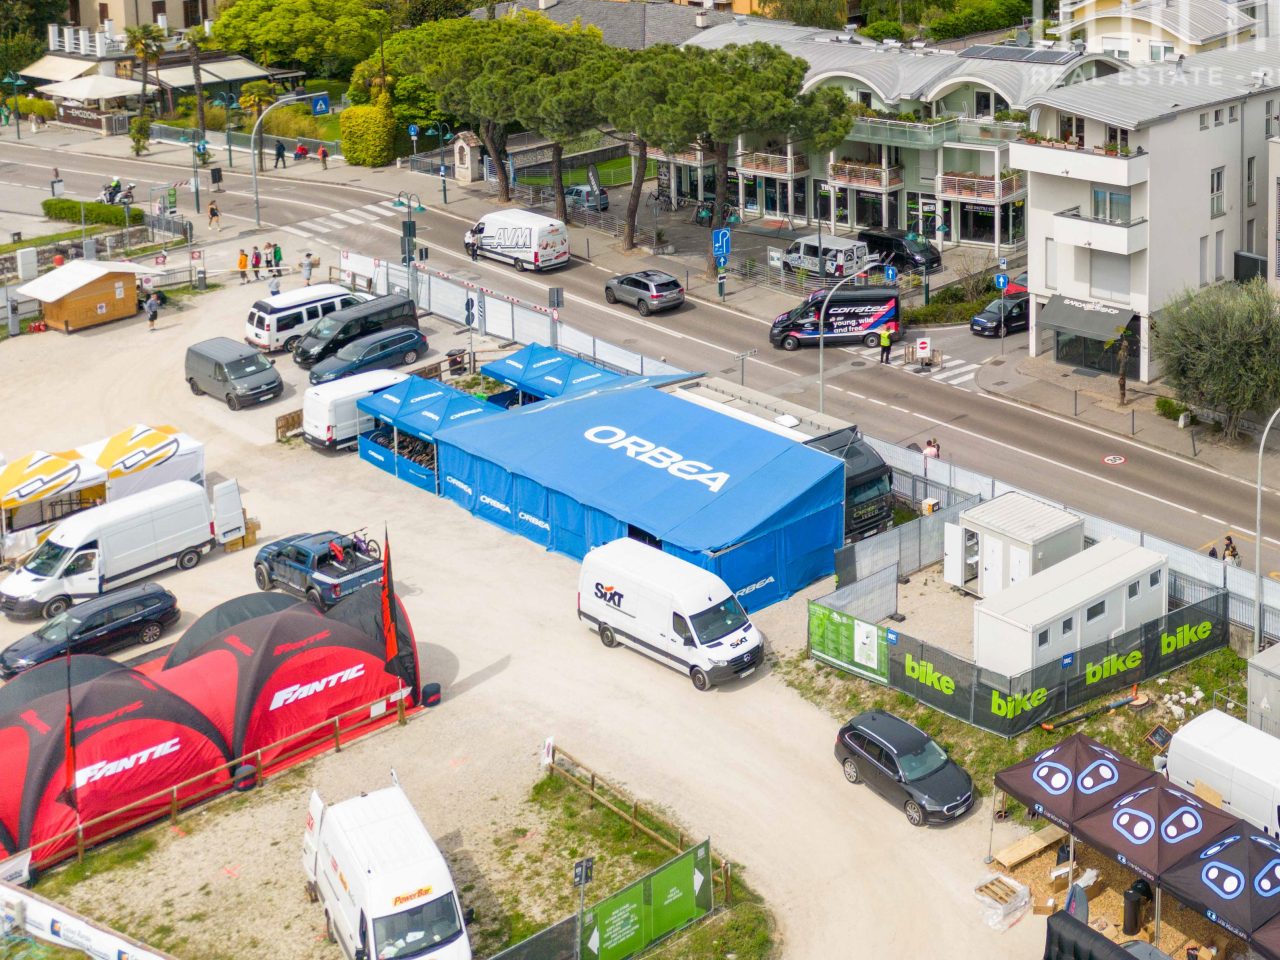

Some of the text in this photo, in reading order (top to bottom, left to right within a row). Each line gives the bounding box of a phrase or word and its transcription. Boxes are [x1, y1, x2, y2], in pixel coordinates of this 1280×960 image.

[489, 228, 532, 248] AVM
[829, 305, 889, 314] corratec
[584, 426, 730, 492] ORBEA
[446, 475, 472, 495] ORBEA
[480, 495, 511, 514] ORBEA
[519, 511, 550, 531] ORBEA
[594, 582, 624, 608] SIXT
[735, 575, 776, 598] RBEA
[1161, 621, 1212, 656] bike
[905, 654, 955, 695] bike
[1085, 649, 1142, 685] bike
[269, 663, 365, 711] FANTIC
[991, 687, 1048, 718] bike
[75, 737, 181, 788] FANTIC
[394, 886, 432, 906] PowerBar
